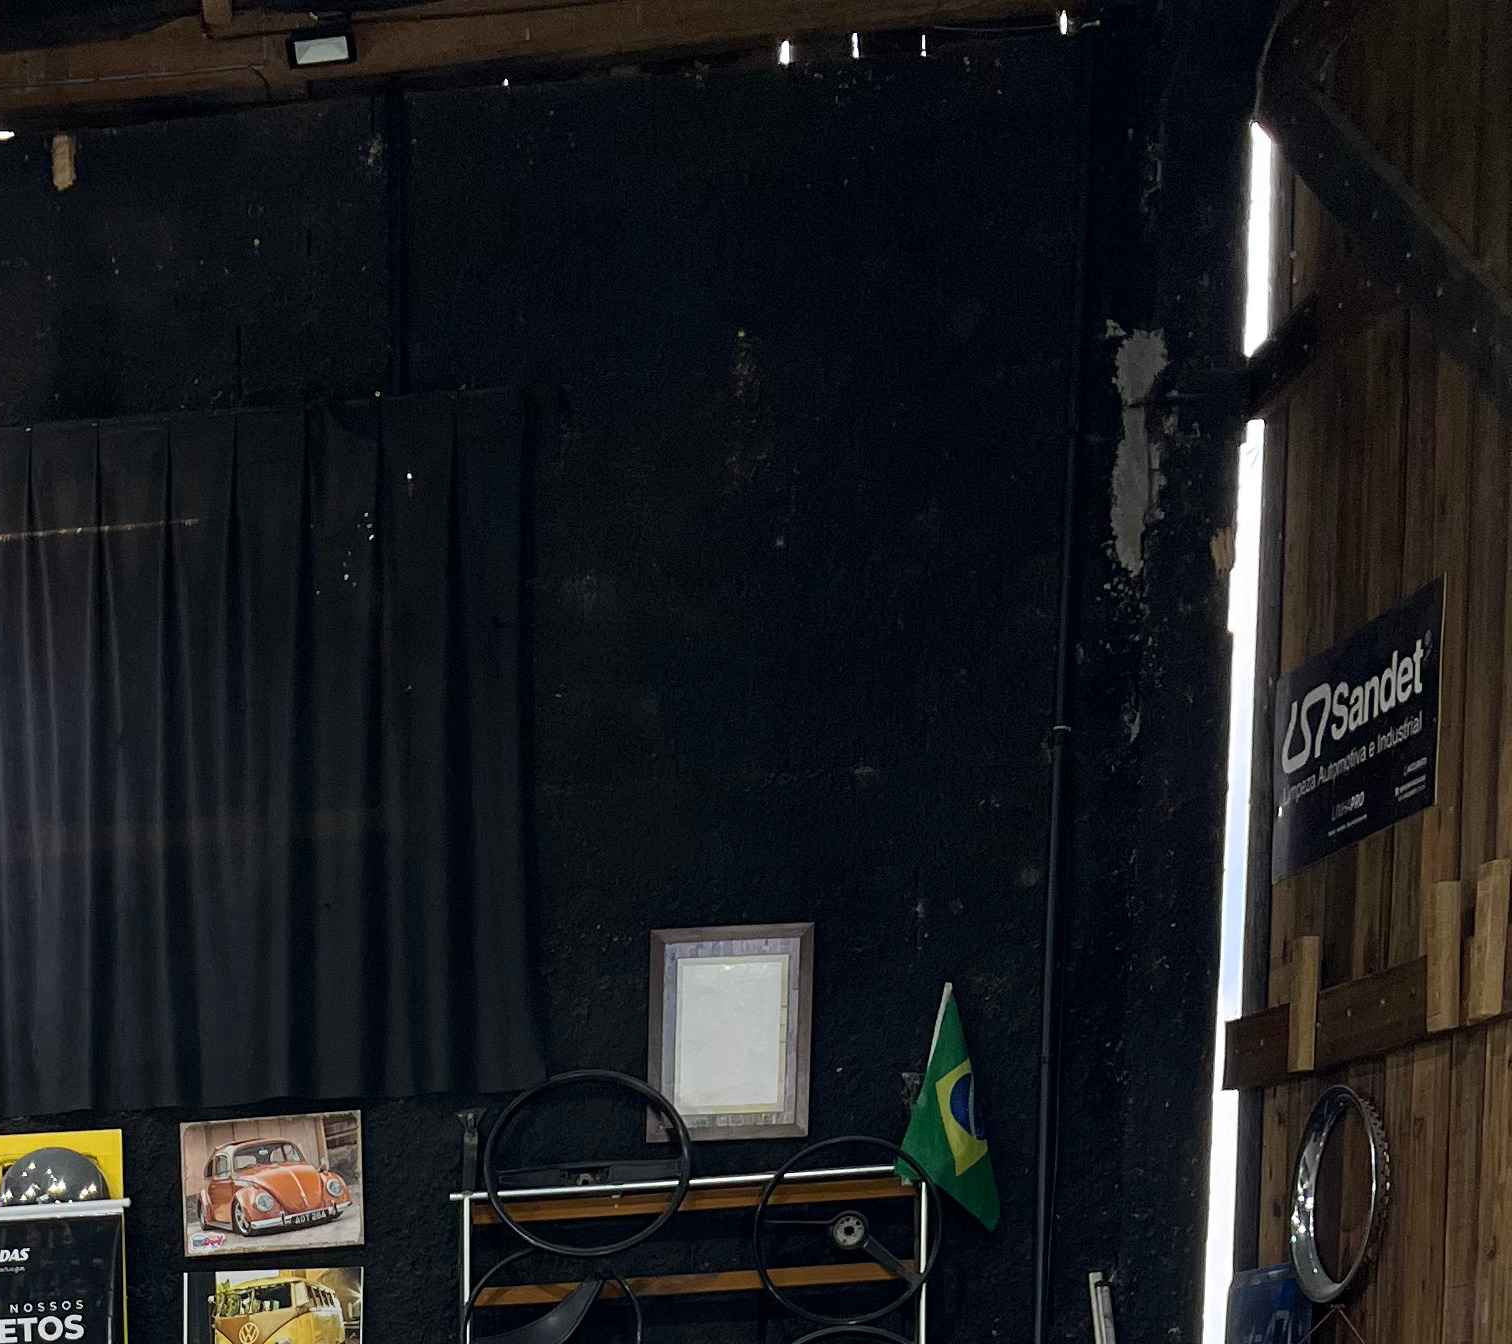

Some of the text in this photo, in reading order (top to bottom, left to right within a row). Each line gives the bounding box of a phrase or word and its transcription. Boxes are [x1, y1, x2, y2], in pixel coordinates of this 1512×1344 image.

[1331, 638, 1424, 740] Sandet
[1319, 744, 1367, 784] Automotiva
[1368, 741, 1375, 758] e
[1377, 709, 1423, 754] Industrial
[9, 1299, 85, 1314] NOSSOS
